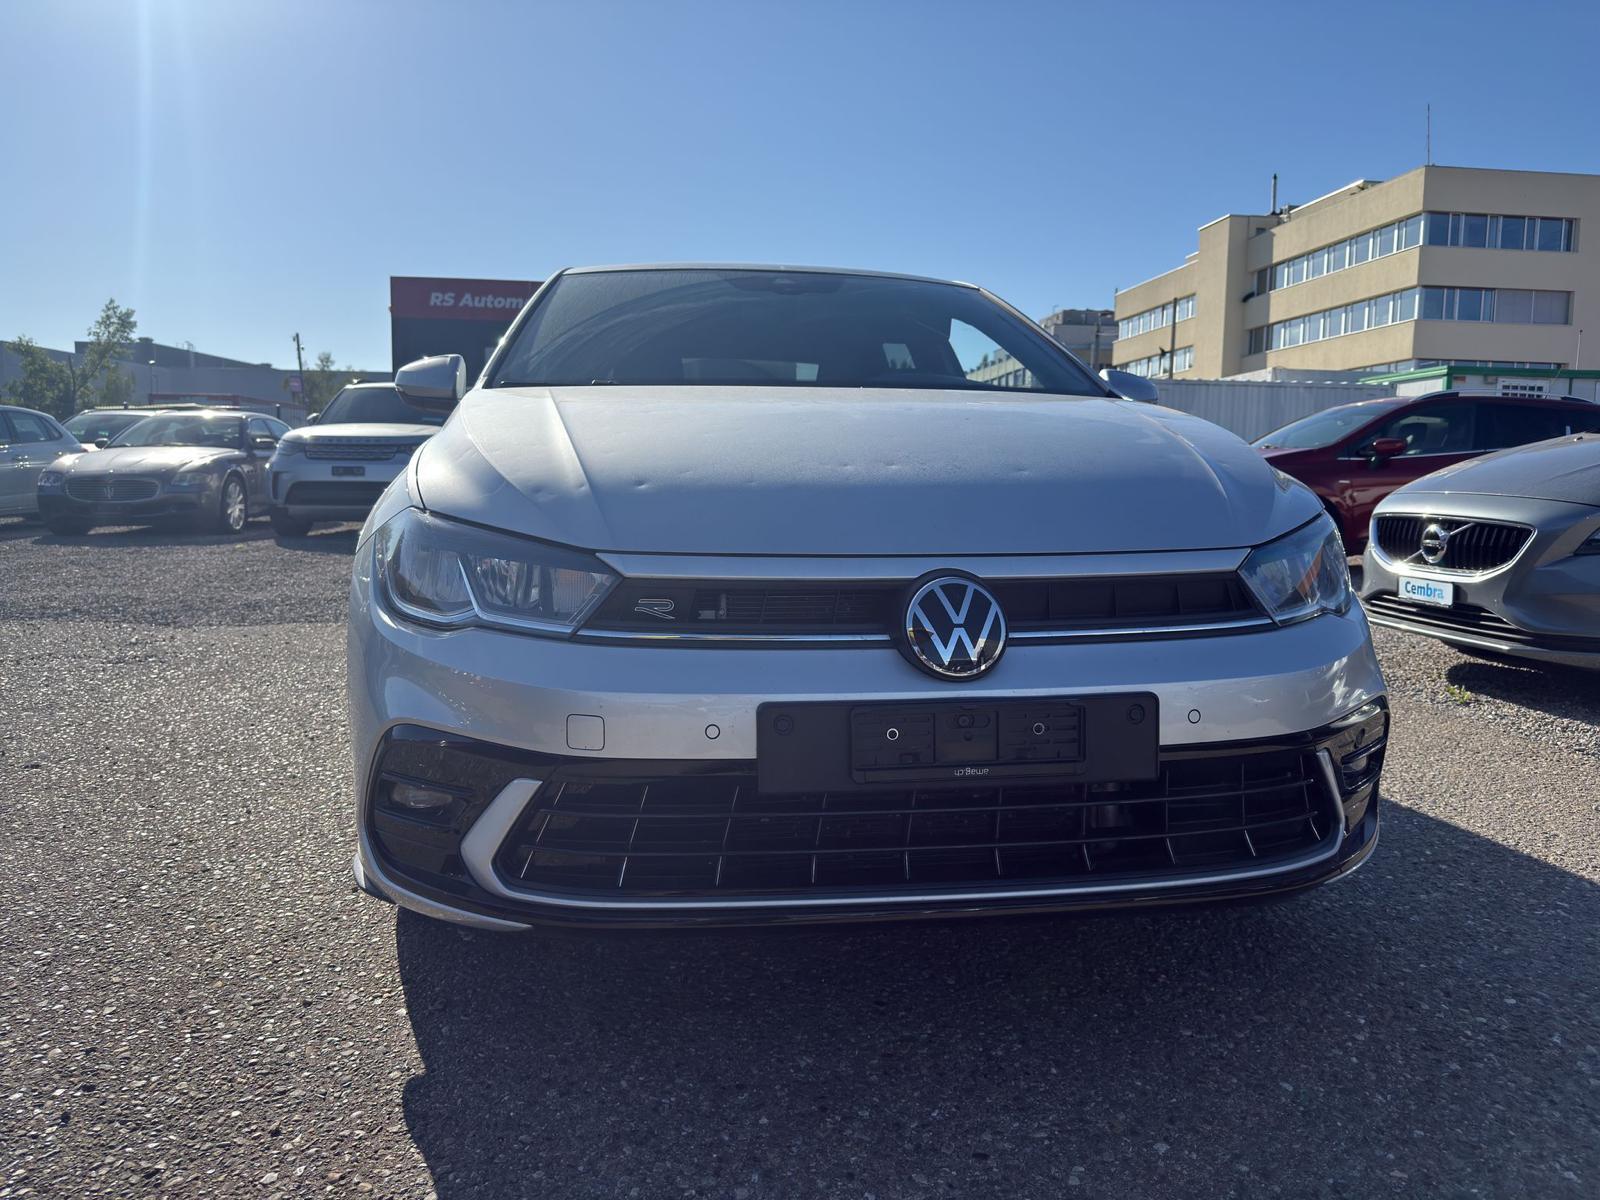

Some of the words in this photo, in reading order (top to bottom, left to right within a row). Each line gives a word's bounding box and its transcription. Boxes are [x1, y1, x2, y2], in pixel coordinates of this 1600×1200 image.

[429, 292, 456, 307] RS
[1404, 581, 1445, 599] Cembra
[907, 578, 1003, 674] VW
[954, 767, 989, 776] amag.ch
